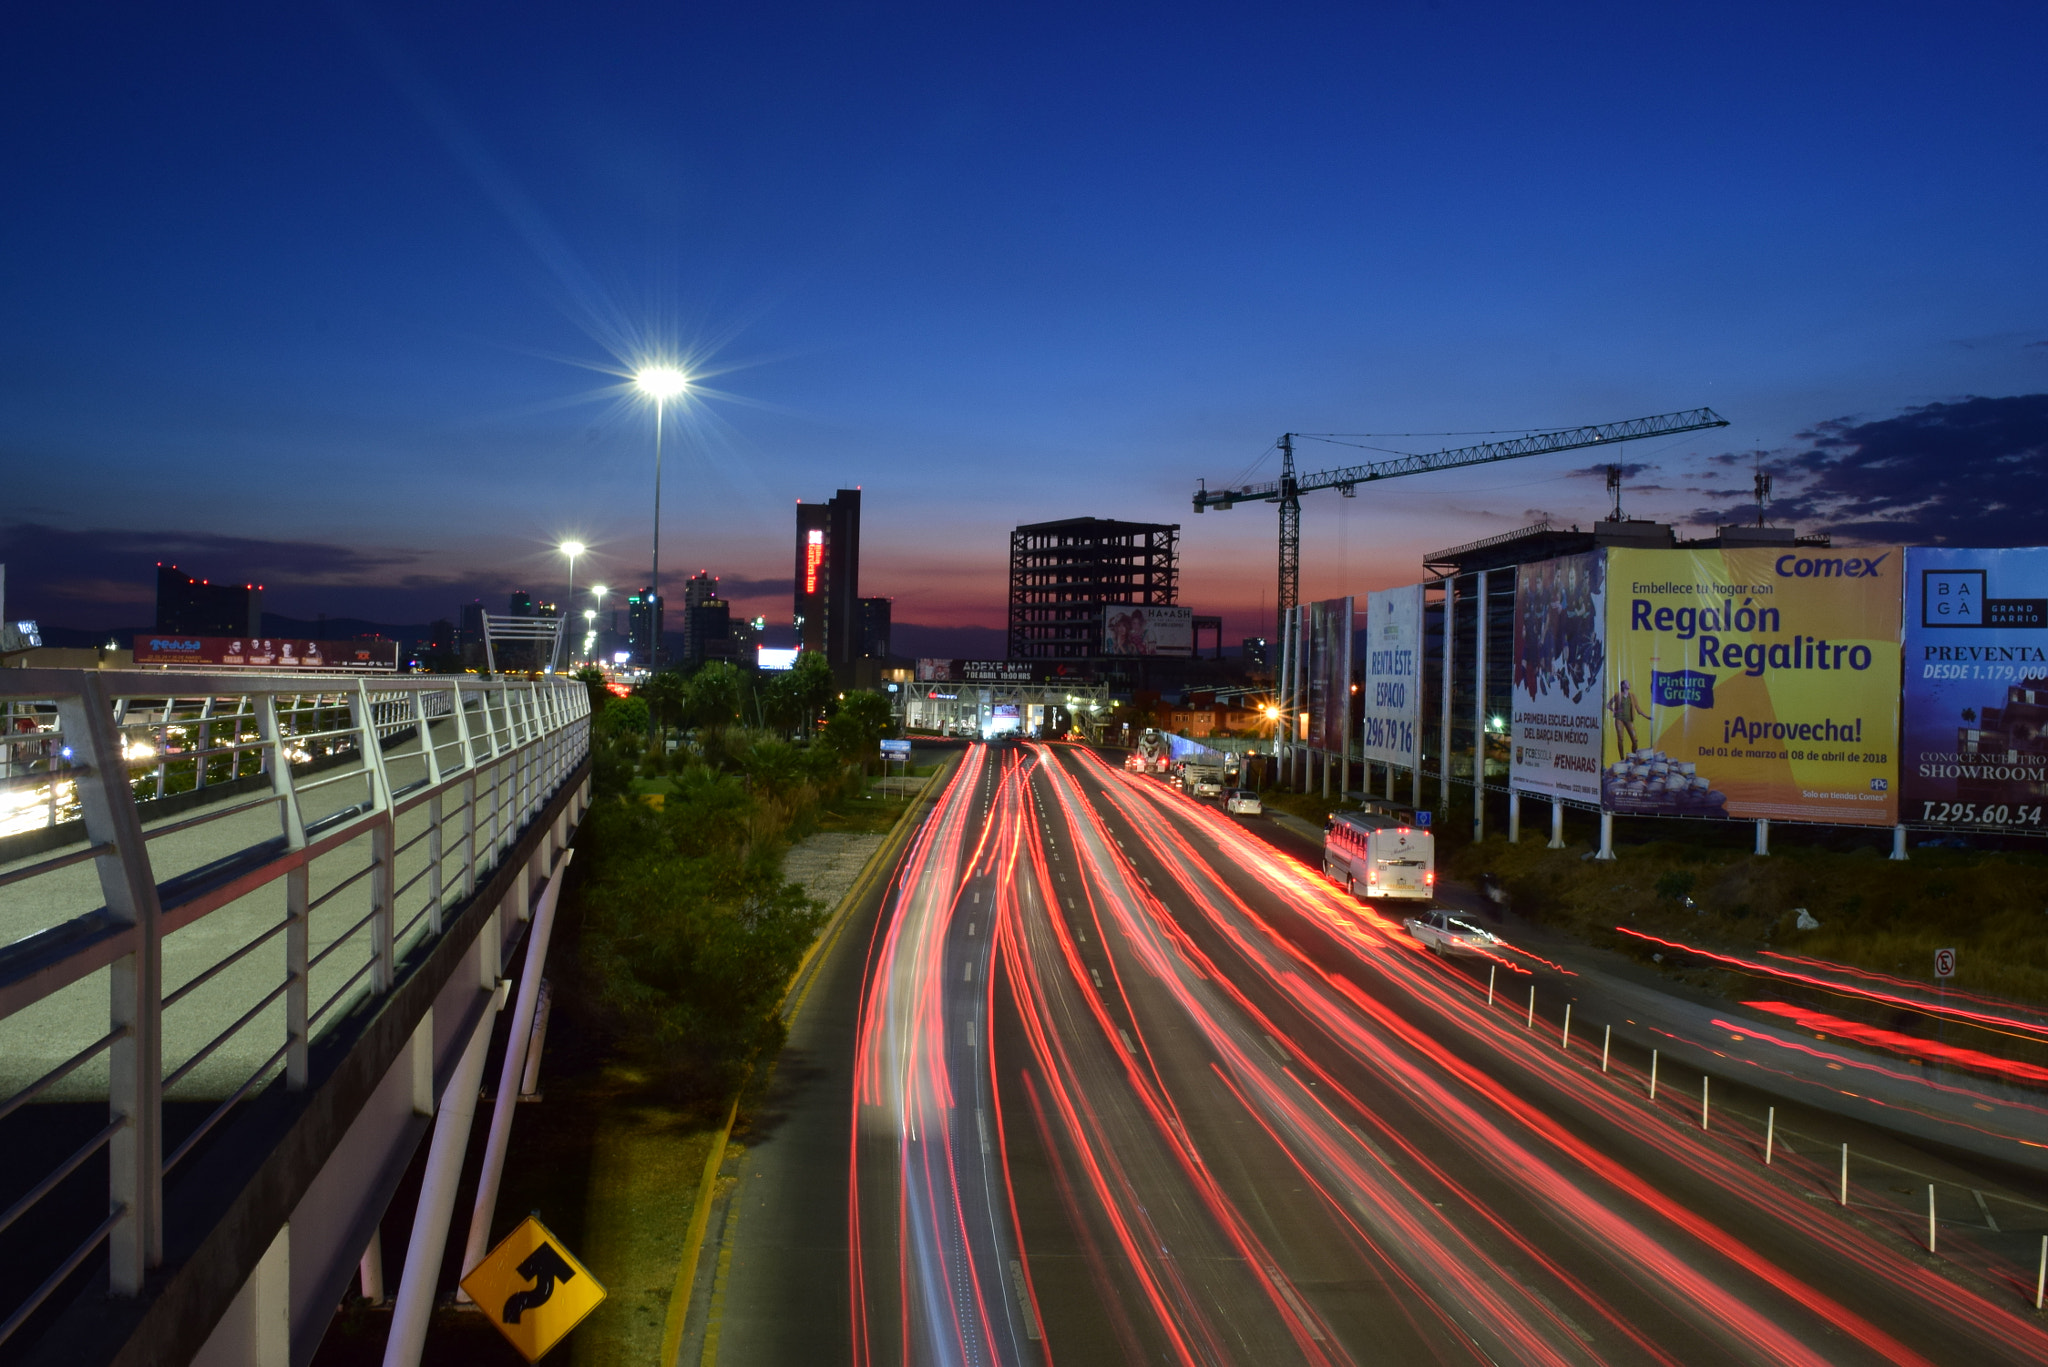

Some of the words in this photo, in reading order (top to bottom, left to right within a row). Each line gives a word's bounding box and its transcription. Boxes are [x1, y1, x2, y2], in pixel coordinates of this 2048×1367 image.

[807, 544, 816, 575] Garden
[1775, 551, 1891, 579] Comex
[807, 575, 816, 593] Inn
[1632, 582, 1692, 594] Embellece
[1696, 583, 1709, 594] tu
[1712, 582, 1748, 597] hogar
[1751, 584, 1774, 595] con
[1631, 597, 1780, 640] Regalón
[1371, 650, 1393, 676] RENTA
[1394, 645, 1412, 676] ÉSTE
[1699, 635, 1872, 677] Regalitro
[1924, 646, 2047, 662] PREVENTA
[963, 661, 1003, 671] ADEXE
[1923, 664, 1970, 679] DESDE
[1973, 665, 2048, 682] 1.179,000
[979, 672, 997, 680] ABRIL
[1018, 672, 1031, 680] HRS
[1658, 676, 1706, 688] Pintura
[1376, 682, 1405, 708] ESPACIO
[1664, 687, 1701, 701] Gratis
[1514, 712, 1523, 723] LA
[1523, 712, 1547, 725] PRIMERA
[1548, 714, 1574, 727] ESCUELA
[1575, 716, 1600, 729] OFICIAL
[1366, 717, 1384, 748] 296
[1385, 718, 1397, 750] 79
[1400, 721, 1412, 753] 16
[1524, 728, 1536, 740] DEL
[1536, 729, 1554, 745] BARÇA
[1554, 730, 1563, 742] EN
[1564, 729, 1589, 745] MÉXICO
[1723, 716, 1862, 745] ¡Aprovecha!
[1698, 746, 1714, 757] Del
[1717, 747, 1728, 757] 01
[1731, 748, 1743, 758] de
[1745, 750, 1777, 759] marzo
[1779, 749, 1789, 760] al
[1791, 750, 1804, 760] 08
[1807, 751, 1819, 761] de
[1821, 751, 1845, 762] abril
[1847, 752, 1860, 763] de
[1862, 753, 1887, 763] 2018
[1920, 752, 1977, 763] CONOCE
[1980, 753, 2047, 765] NUETRO
[1553, 754, 1596, 773] #ENHARAS
[1919, 764, 2046, 781] SHOWROOM
[1871, 779, 1888, 790] PPG
[1802, 790, 1819, 799] Solo
[1830, 791, 1858, 800] tiendas
[1923, 801, 2042, 825] T.295.60.54
